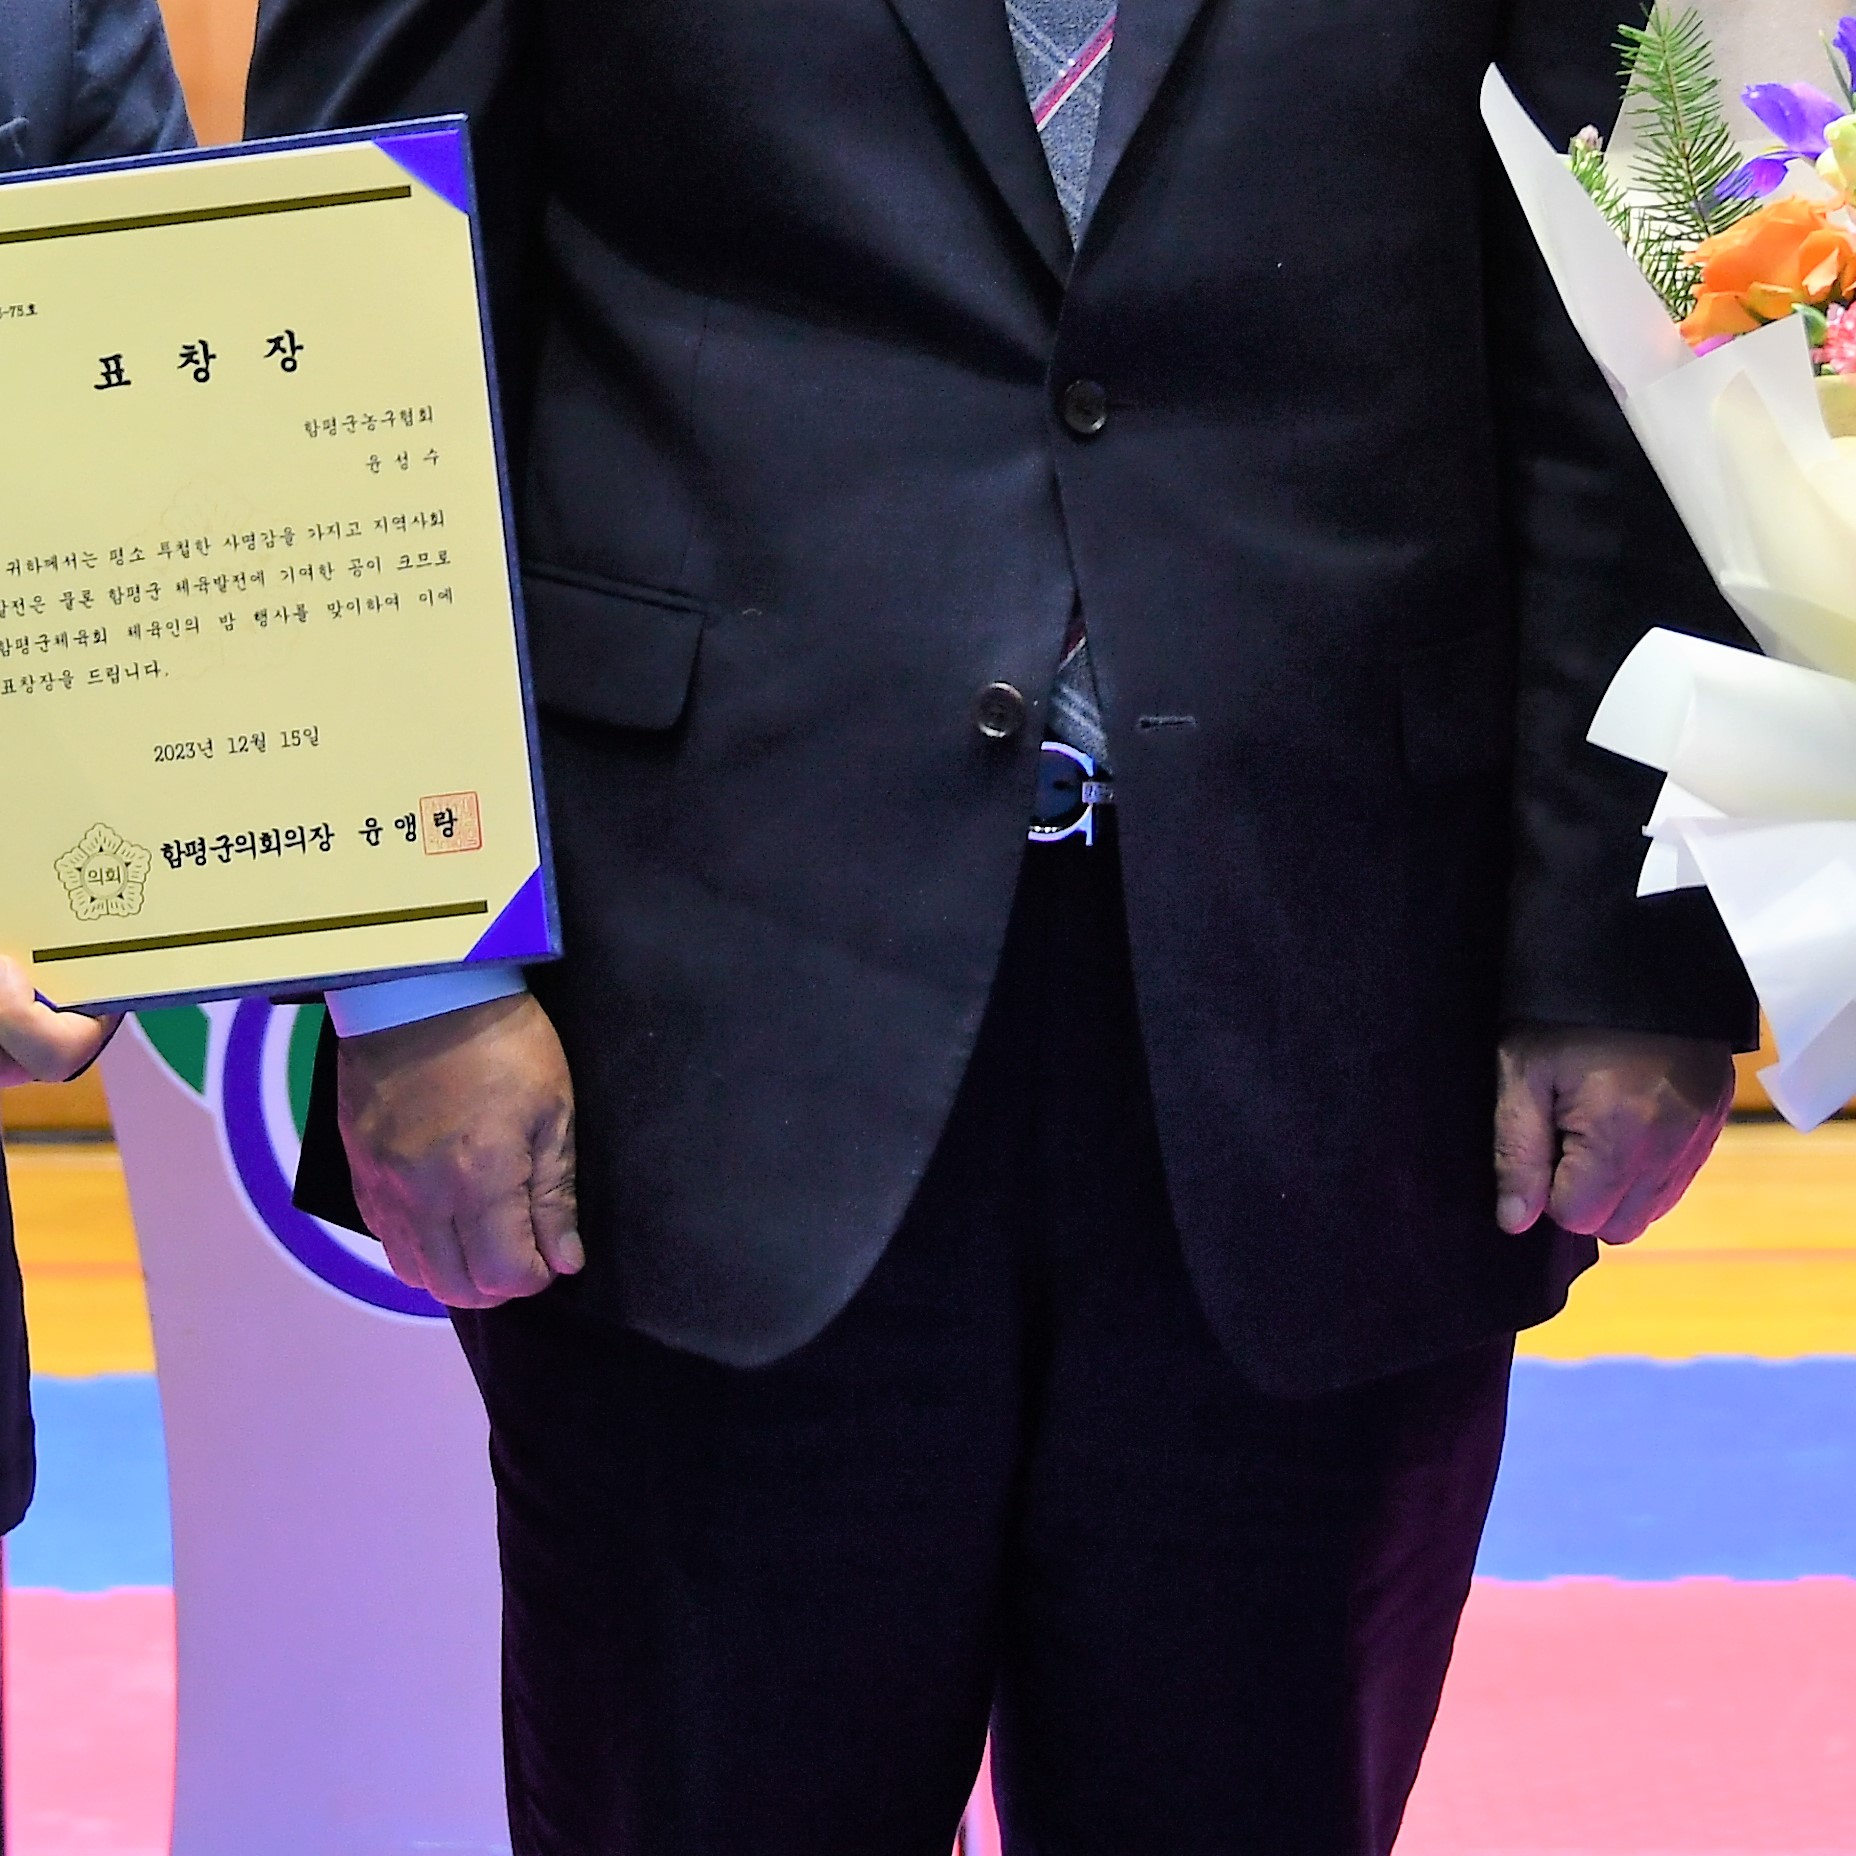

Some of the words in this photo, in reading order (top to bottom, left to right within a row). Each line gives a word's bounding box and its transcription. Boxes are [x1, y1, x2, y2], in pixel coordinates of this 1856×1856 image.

[304, 404, 433, 438] 함평군농구협회
[109, 546, 146, 566] 평소
[223, 526, 296, 551] 사명감을
[307, 521, 362, 542] 가지고
[373, 509, 444, 534] 지역사회
[58, 589, 95, 611] 물론
[108, 581, 162, 606] 함평군
[280, 561, 335, 584] 기여한
[347, 555, 381, 578] 공이
[396, 549, 451, 571] 크므로
[218, 611, 236, 632] 밤
[253, 603, 309, 628] 행사를
[327, 592, 400, 620] 맞이하여
[418, 586, 453, 607] 이에
[0, 669, 74, 696] 표창장을
[87, 659, 169, 685] 드립니다.
[153, 737, 214, 763] 2023년
[227, 731, 266, 754] 12월
[280, 725, 319, 748] 15일
[160, 822, 336, 870] 함평군의회의장
[88, 866, 121, 886] 의회
